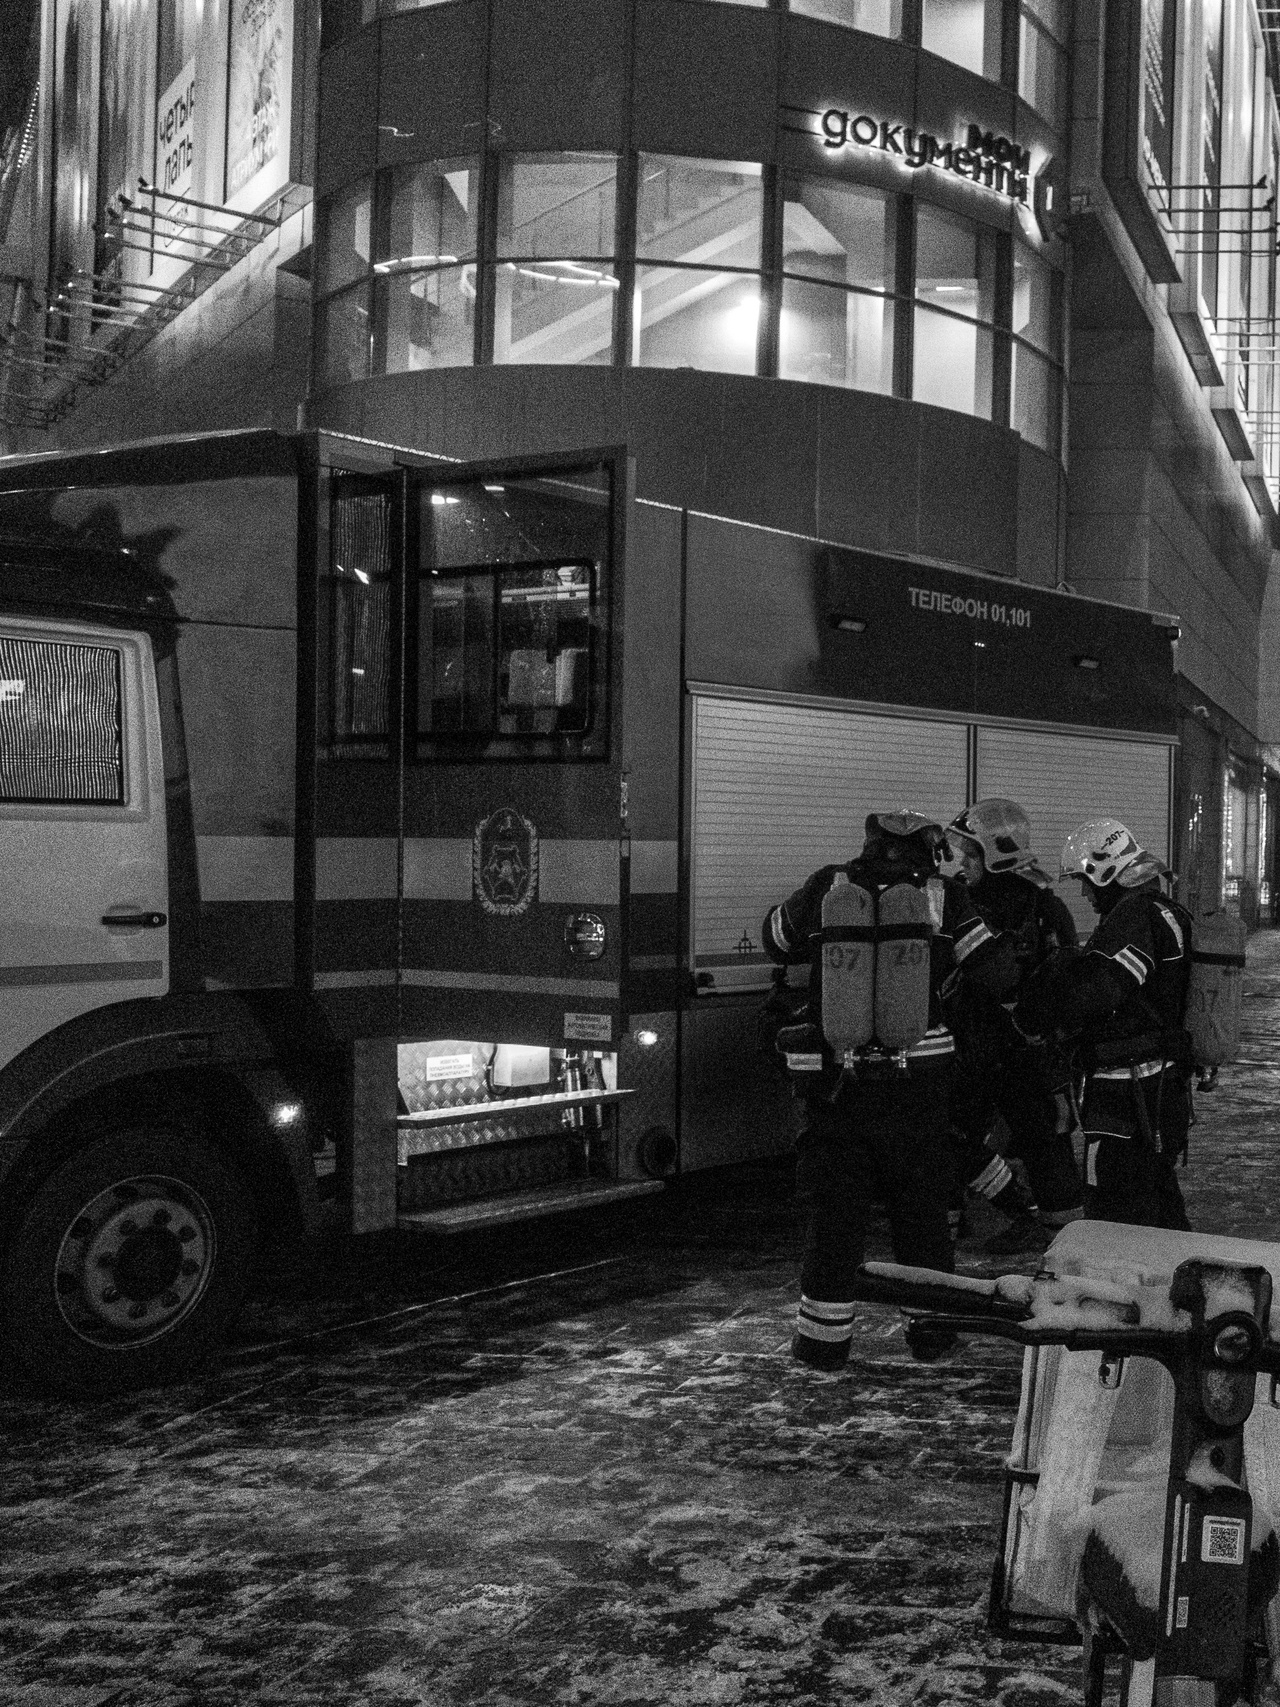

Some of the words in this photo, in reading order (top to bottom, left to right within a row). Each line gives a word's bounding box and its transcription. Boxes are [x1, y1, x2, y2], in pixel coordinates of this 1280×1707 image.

[821, 109, 1028, 202] документы
[908, 586, 988, 620] ТЕЛЕФОН
[990, 603, 1031, 628] 01,101
